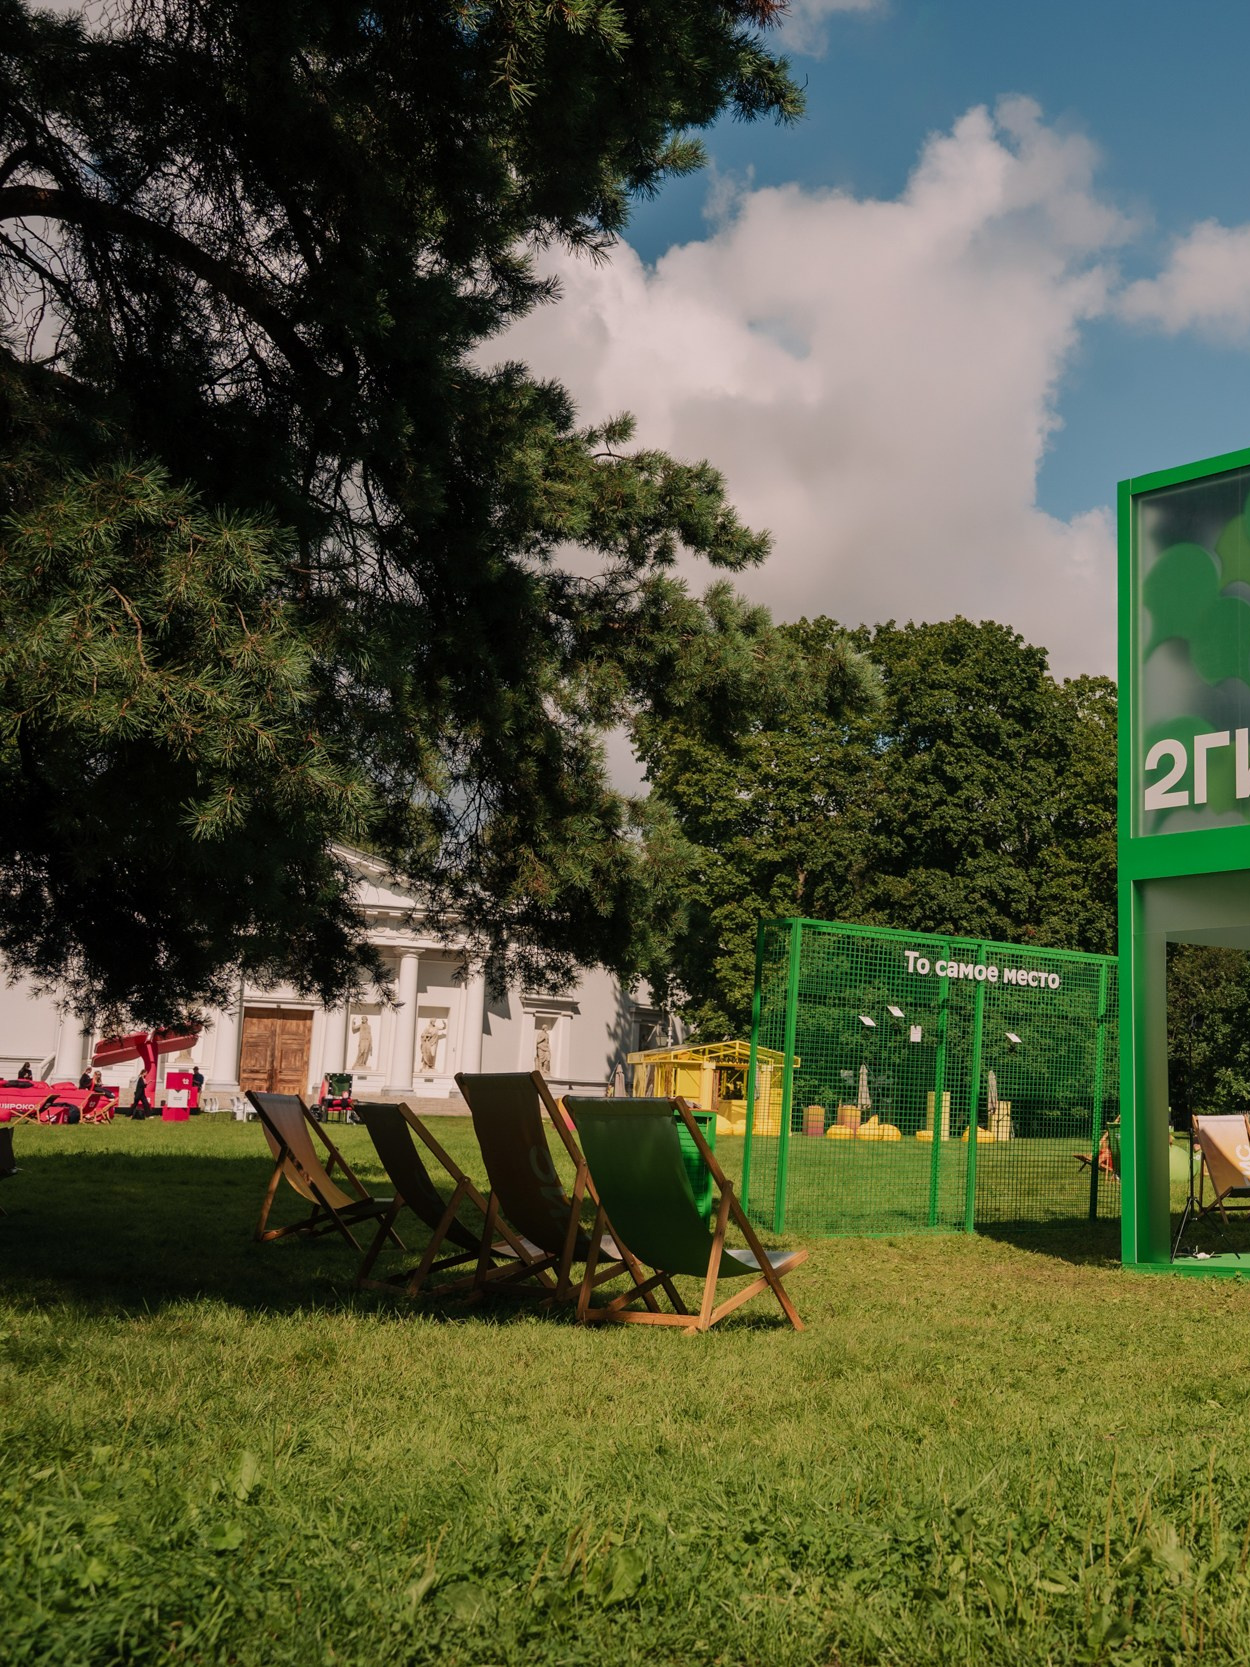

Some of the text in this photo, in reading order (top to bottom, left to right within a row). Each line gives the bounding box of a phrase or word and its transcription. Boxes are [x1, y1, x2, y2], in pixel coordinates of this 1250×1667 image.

[904, 950, 1060, 989] То самое место
